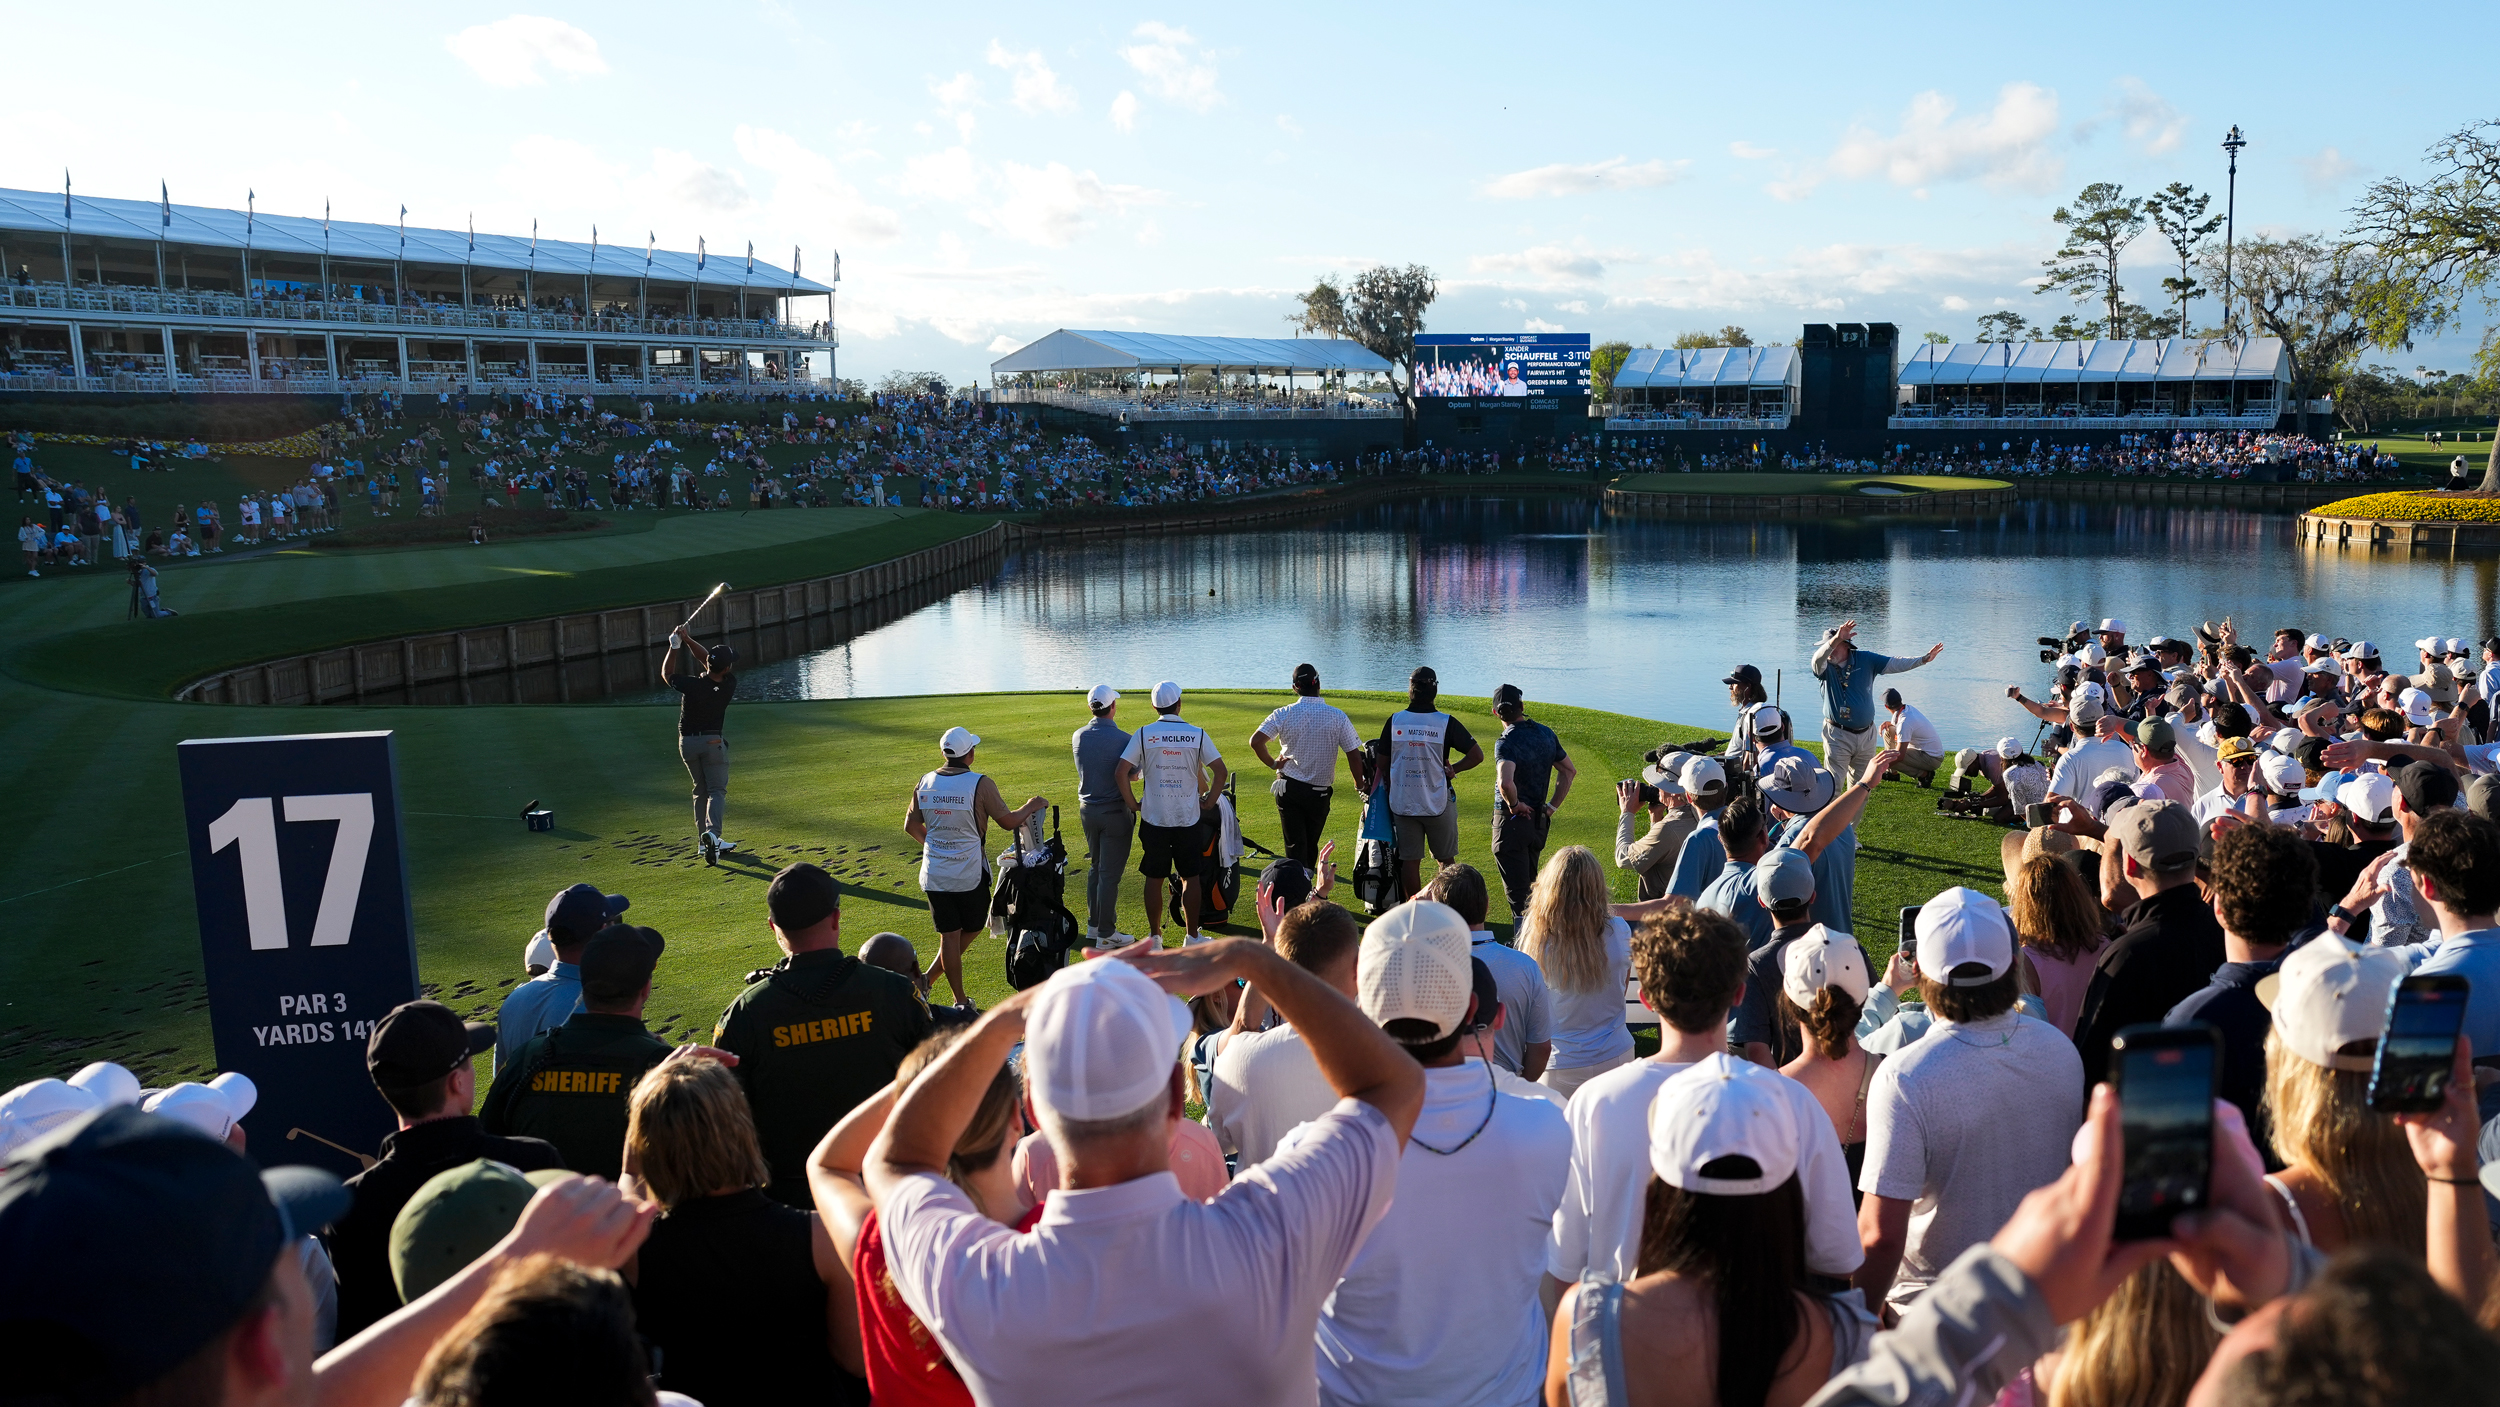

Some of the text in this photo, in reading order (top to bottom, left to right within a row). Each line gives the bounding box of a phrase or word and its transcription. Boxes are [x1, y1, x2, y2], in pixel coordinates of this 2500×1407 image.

[1577, 351, 1590, 360] T10
[1448, 401, 1471, 410] Optum
[1479, 401, 1522, 409] Morgan Stanley
[1408, 729, 1438, 738] MATSUYAMA
[933, 795, 965, 804] SCHAUFFELE
[208, 792, 375, 950] 17
[279, 992, 347, 1016] PAR 3
[252, 1019, 375, 1047] YARDS 141
[772, 1010, 873, 1048] SHERIFF
[531, 1070, 621, 1094] SHERIFF
